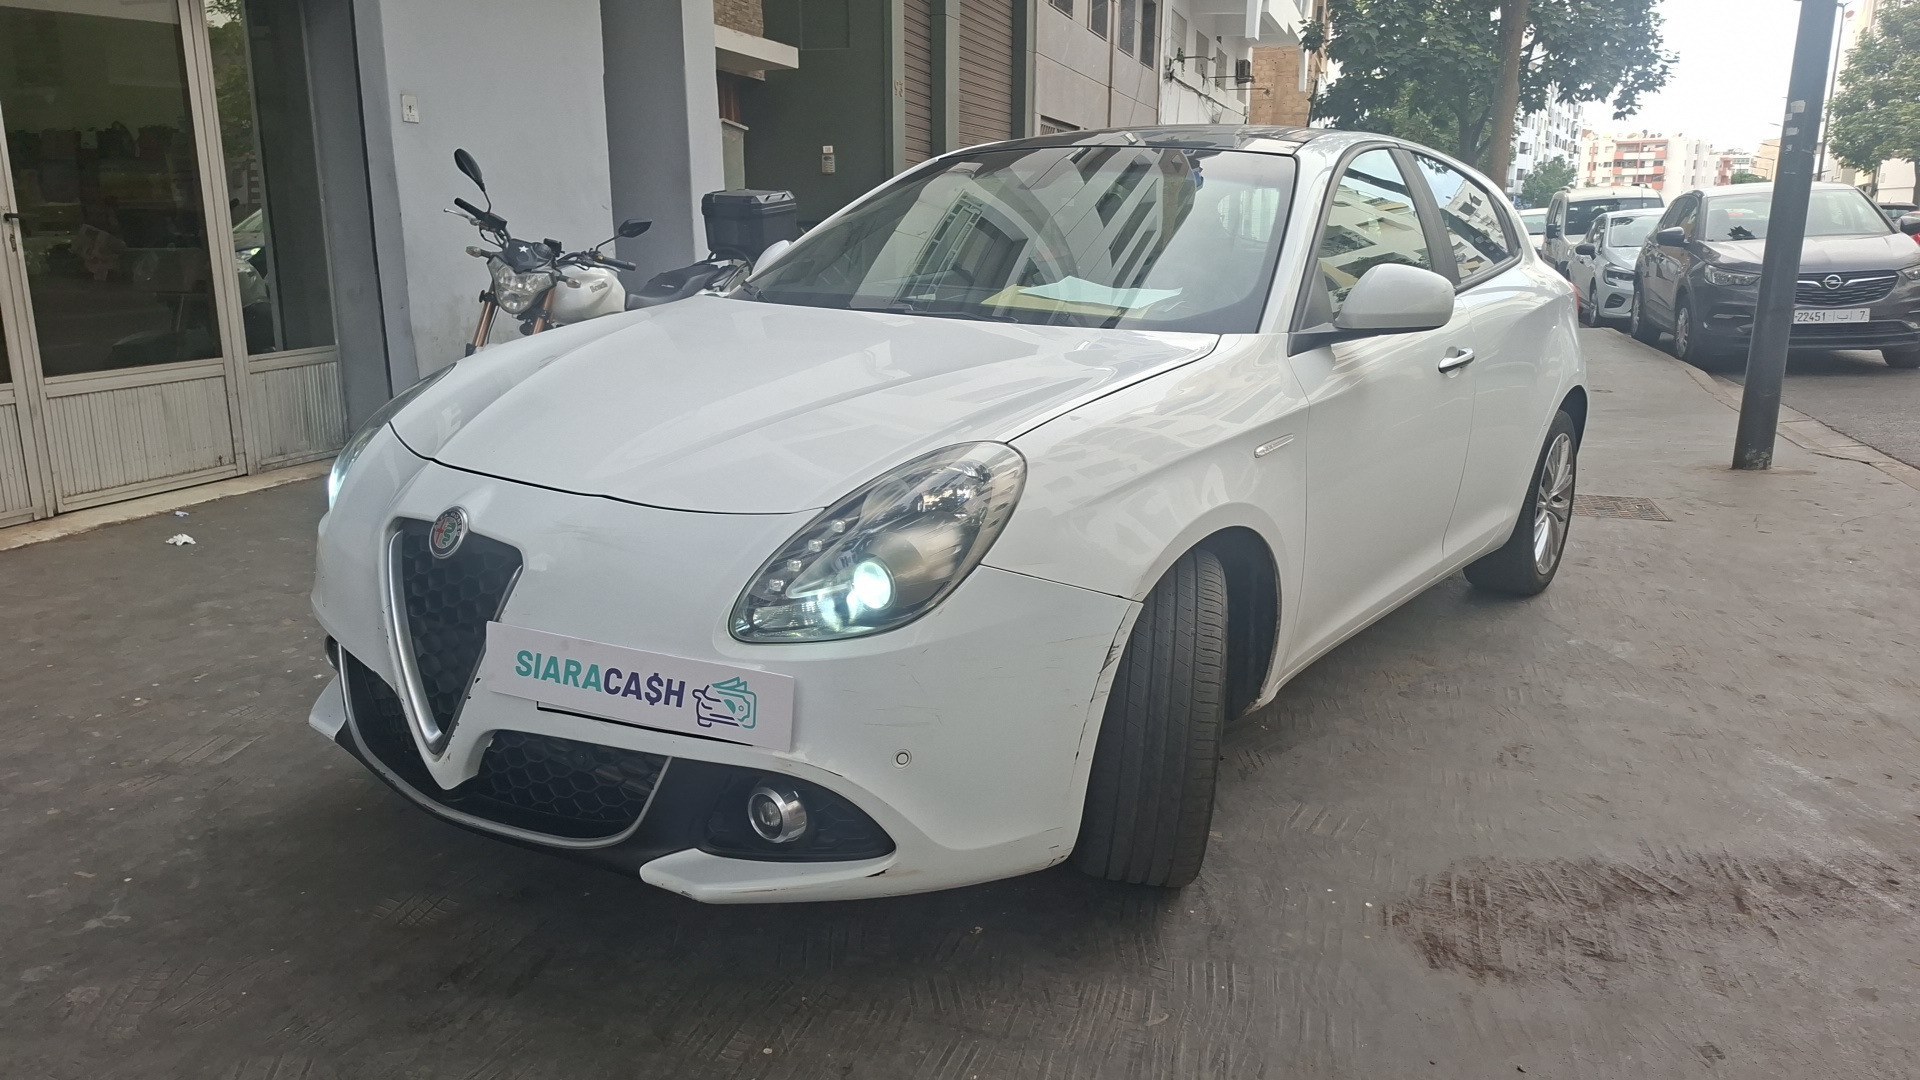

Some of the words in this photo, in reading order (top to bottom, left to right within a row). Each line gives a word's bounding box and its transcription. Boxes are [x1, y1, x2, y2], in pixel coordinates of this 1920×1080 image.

[1797, 312, 1826, 322] 22451
[1860, 311, 1866, 320] 7
[515, 650, 686, 708] SIARACA$H
